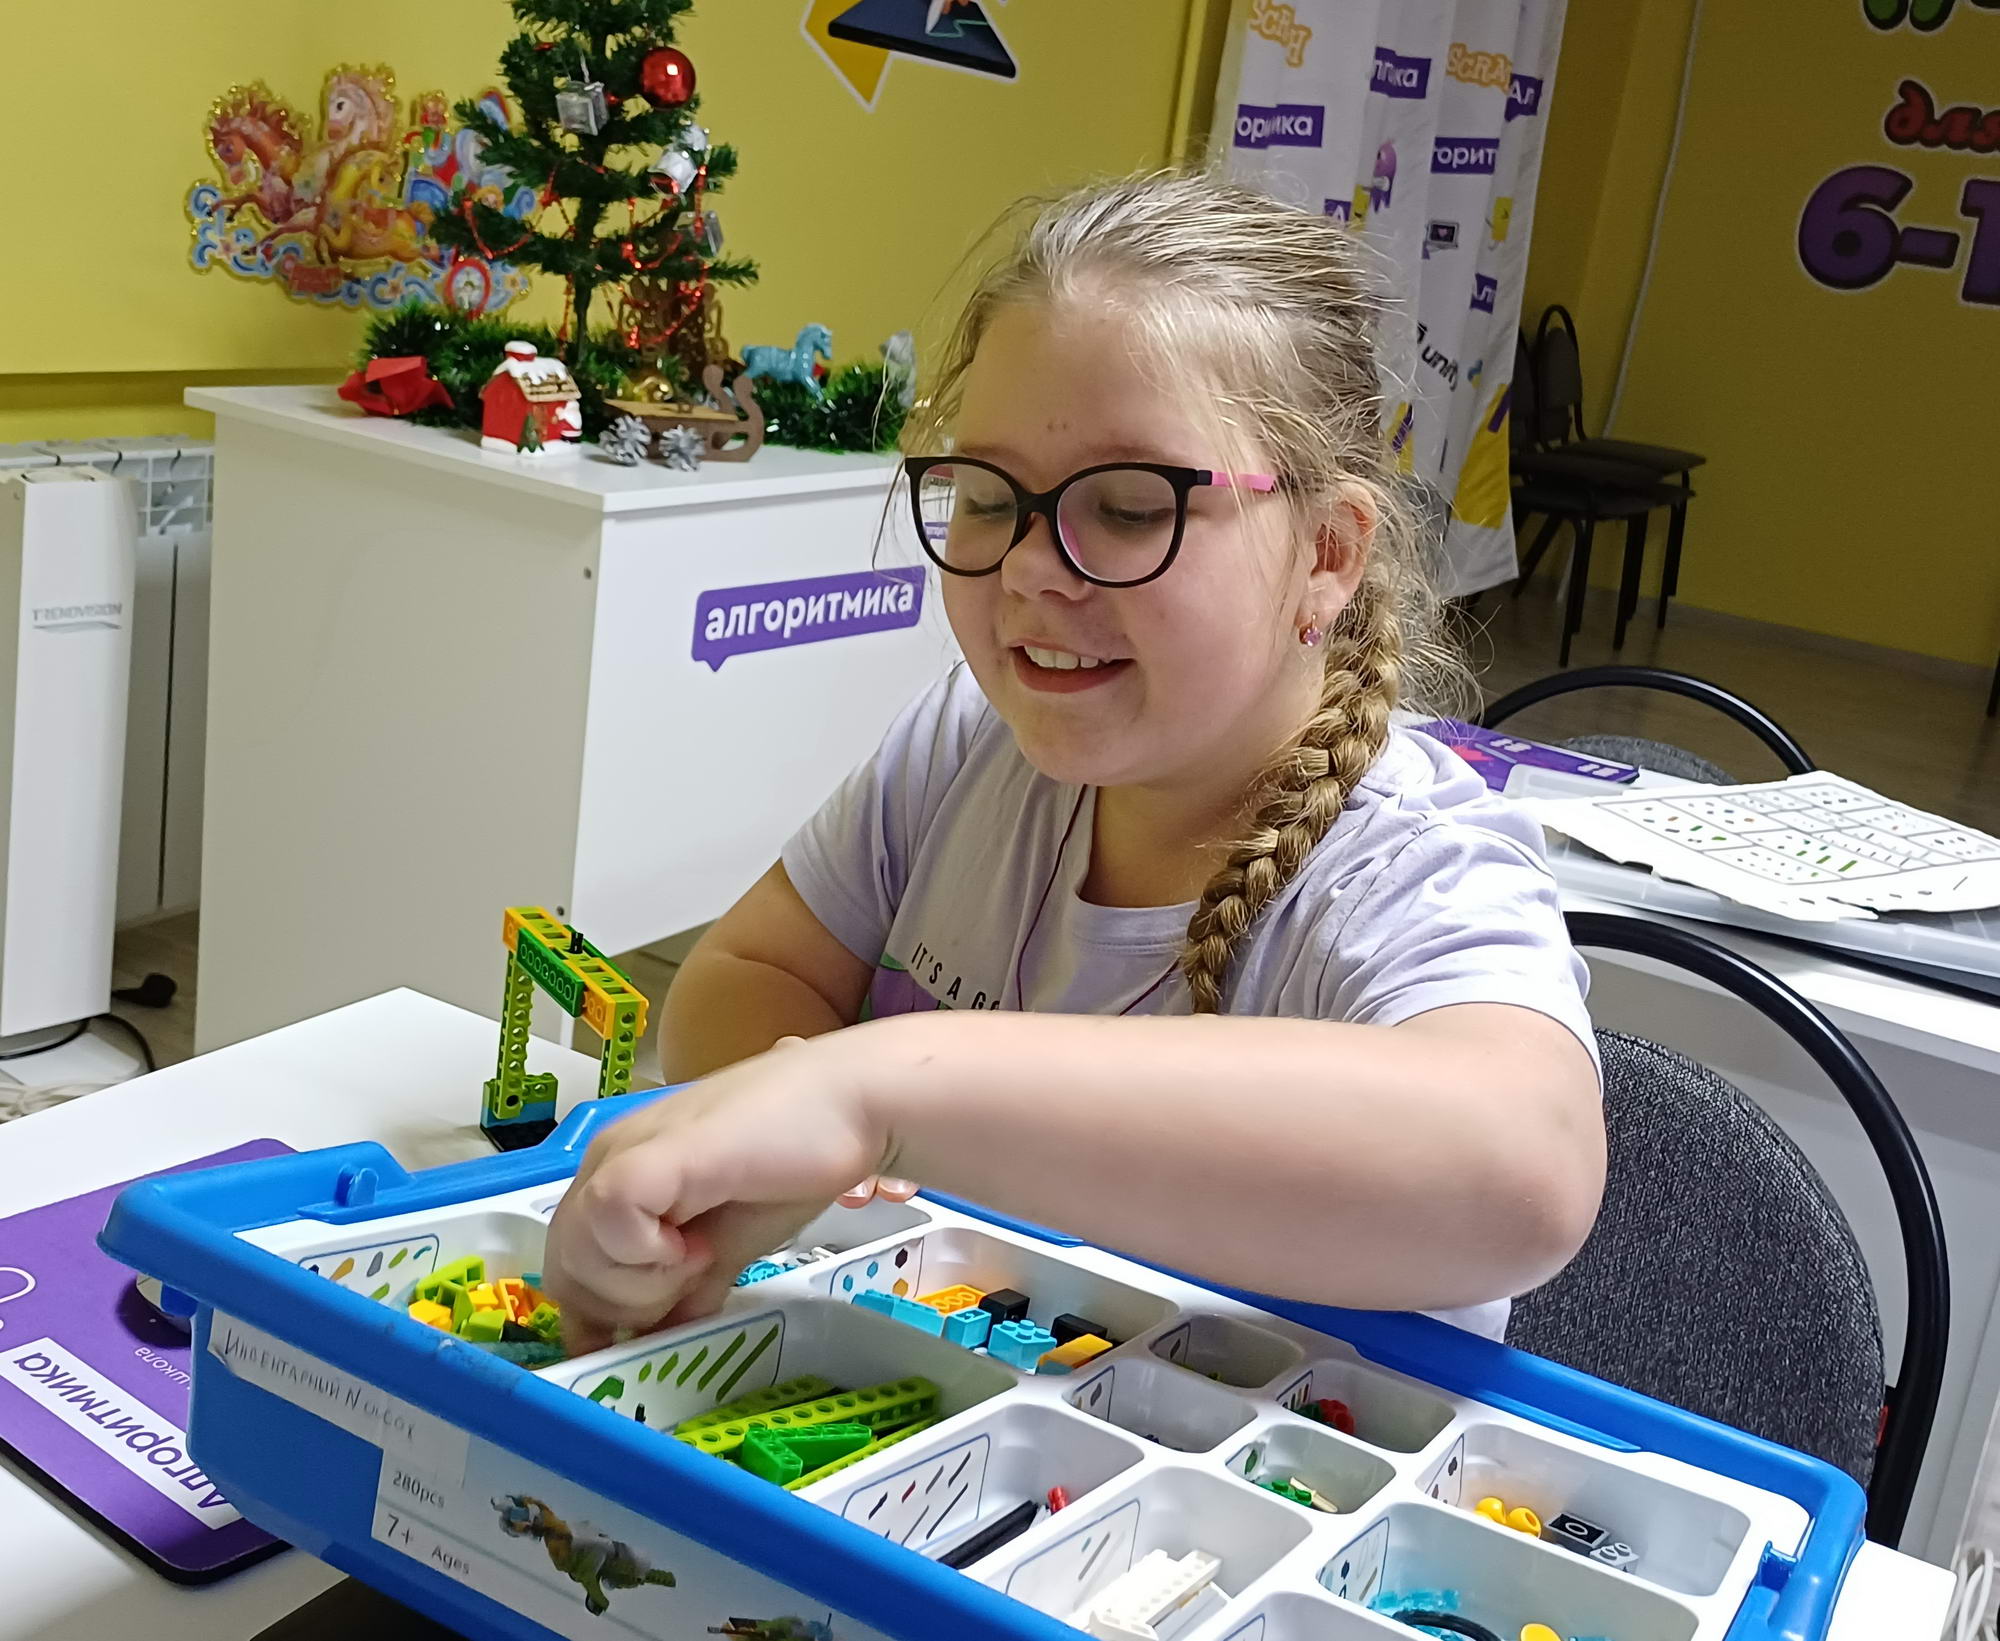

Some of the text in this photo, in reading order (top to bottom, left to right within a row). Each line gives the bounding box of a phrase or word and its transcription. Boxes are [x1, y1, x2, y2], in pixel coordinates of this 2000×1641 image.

[704, 582, 914, 641] алгоритмика
[911, 941, 943, 985] IT'S
[946, 975, 962, 1000] A
[134, 1346, 191, 1386] школа
[13, 1352, 229, 1509] Алгоритмика
[392, 1470, 446, 1508] 280pcs
[387, 1513, 471, 1575] 7+ Ages
